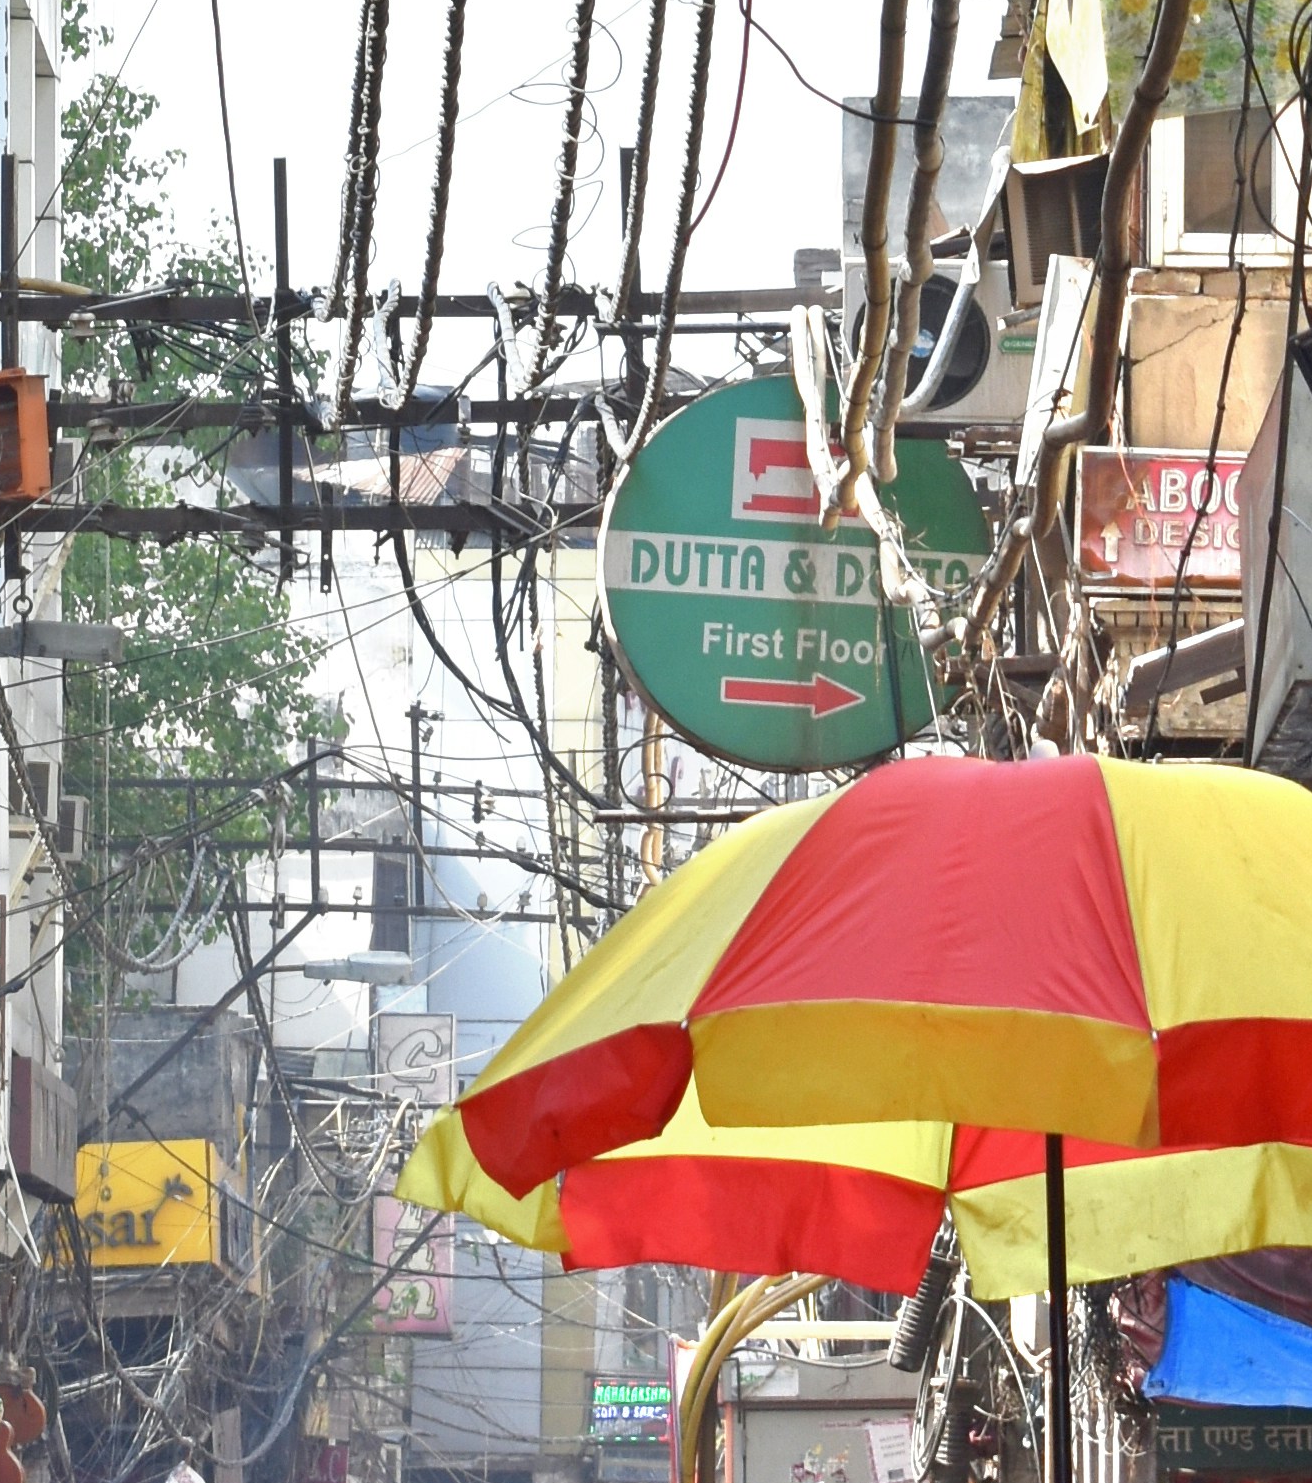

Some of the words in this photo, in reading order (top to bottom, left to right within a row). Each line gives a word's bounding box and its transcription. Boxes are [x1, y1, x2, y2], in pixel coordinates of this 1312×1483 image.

[630, 538, 765, 591] DUTTA
[783, 548, 819, 595] &
[702, 622, 784, 660] First
